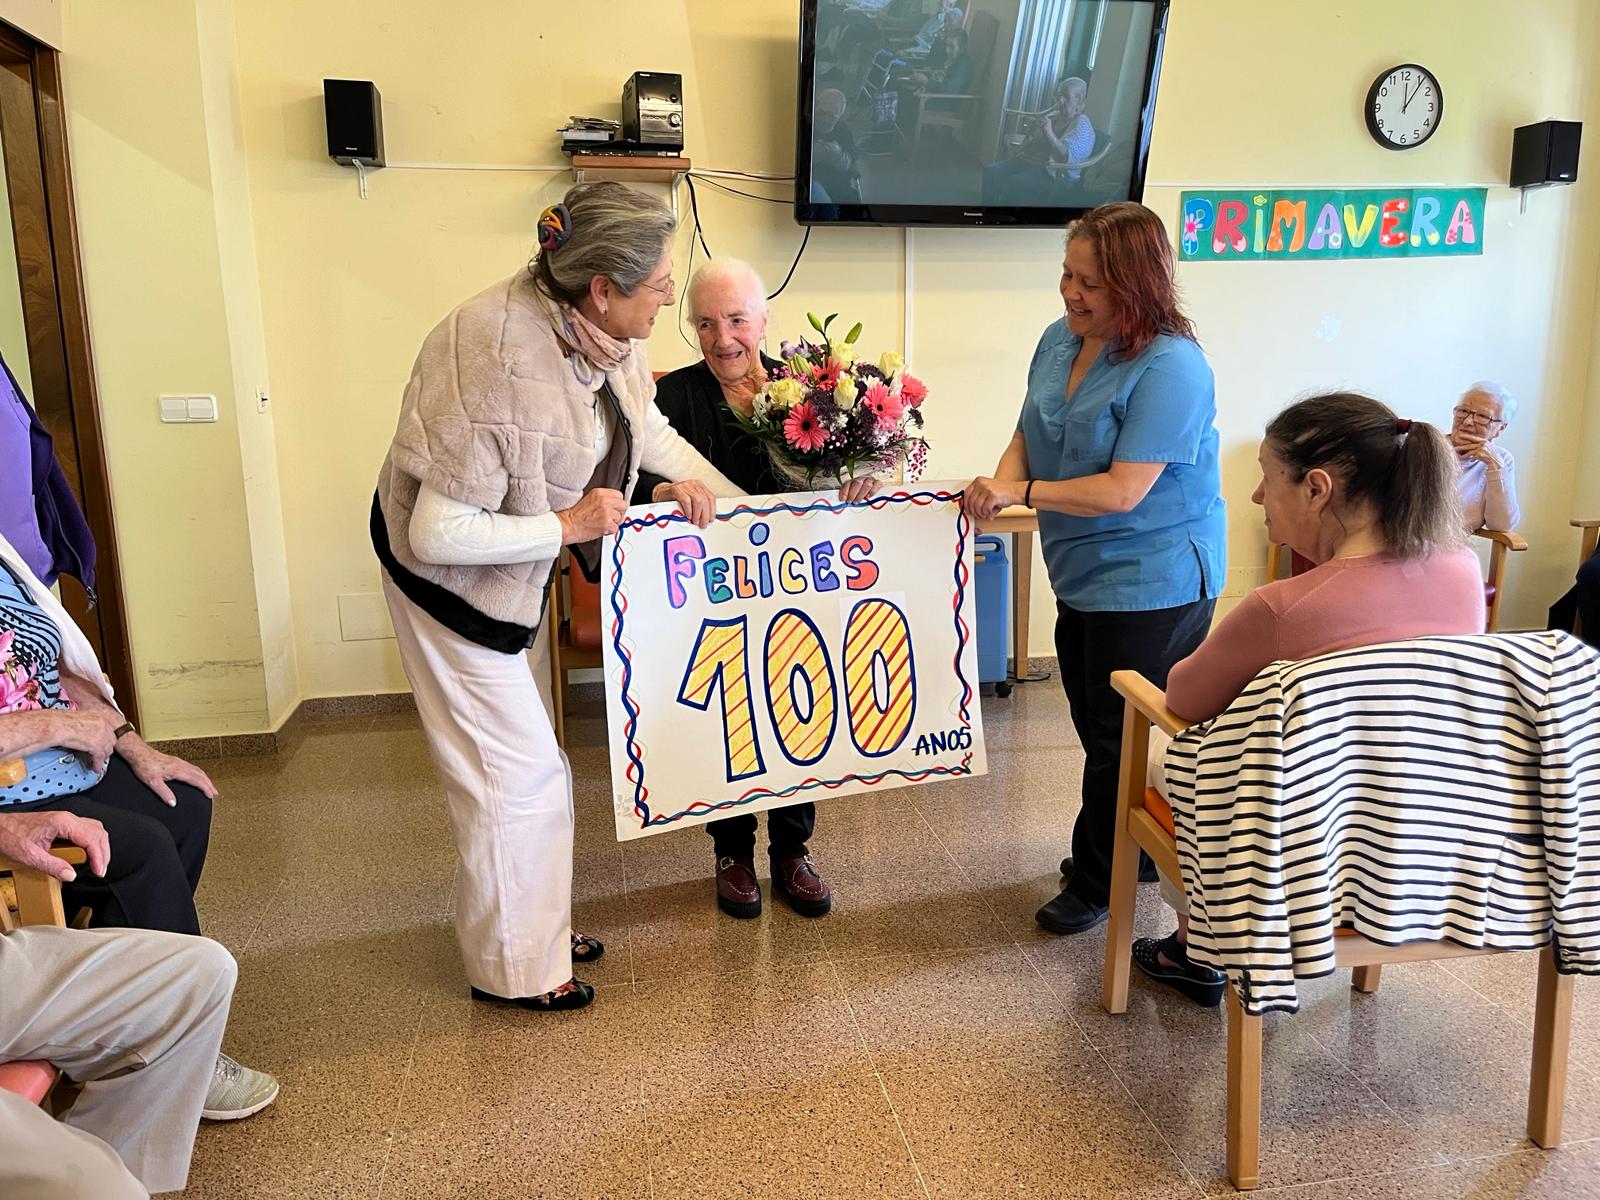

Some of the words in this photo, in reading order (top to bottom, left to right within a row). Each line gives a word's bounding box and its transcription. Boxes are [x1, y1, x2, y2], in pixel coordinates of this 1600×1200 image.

[1389, 75, 1397, 85] 11
[1401, 71, 1411, 81] 12
[1424, 87, 1431, 97] 2
[1374, 103, 1381, 113] 9
[1427, 102, 1434, 112] 3
[1377, 119, 1384, 129] 8
[1423, 118, 1430, 128] 4
[1387, 130, 1393, 141] 7
[1400, 134, 1407, 144] 6
[1413, 129, 1420, 139] 5
[676, 598, 917, 783] 100
